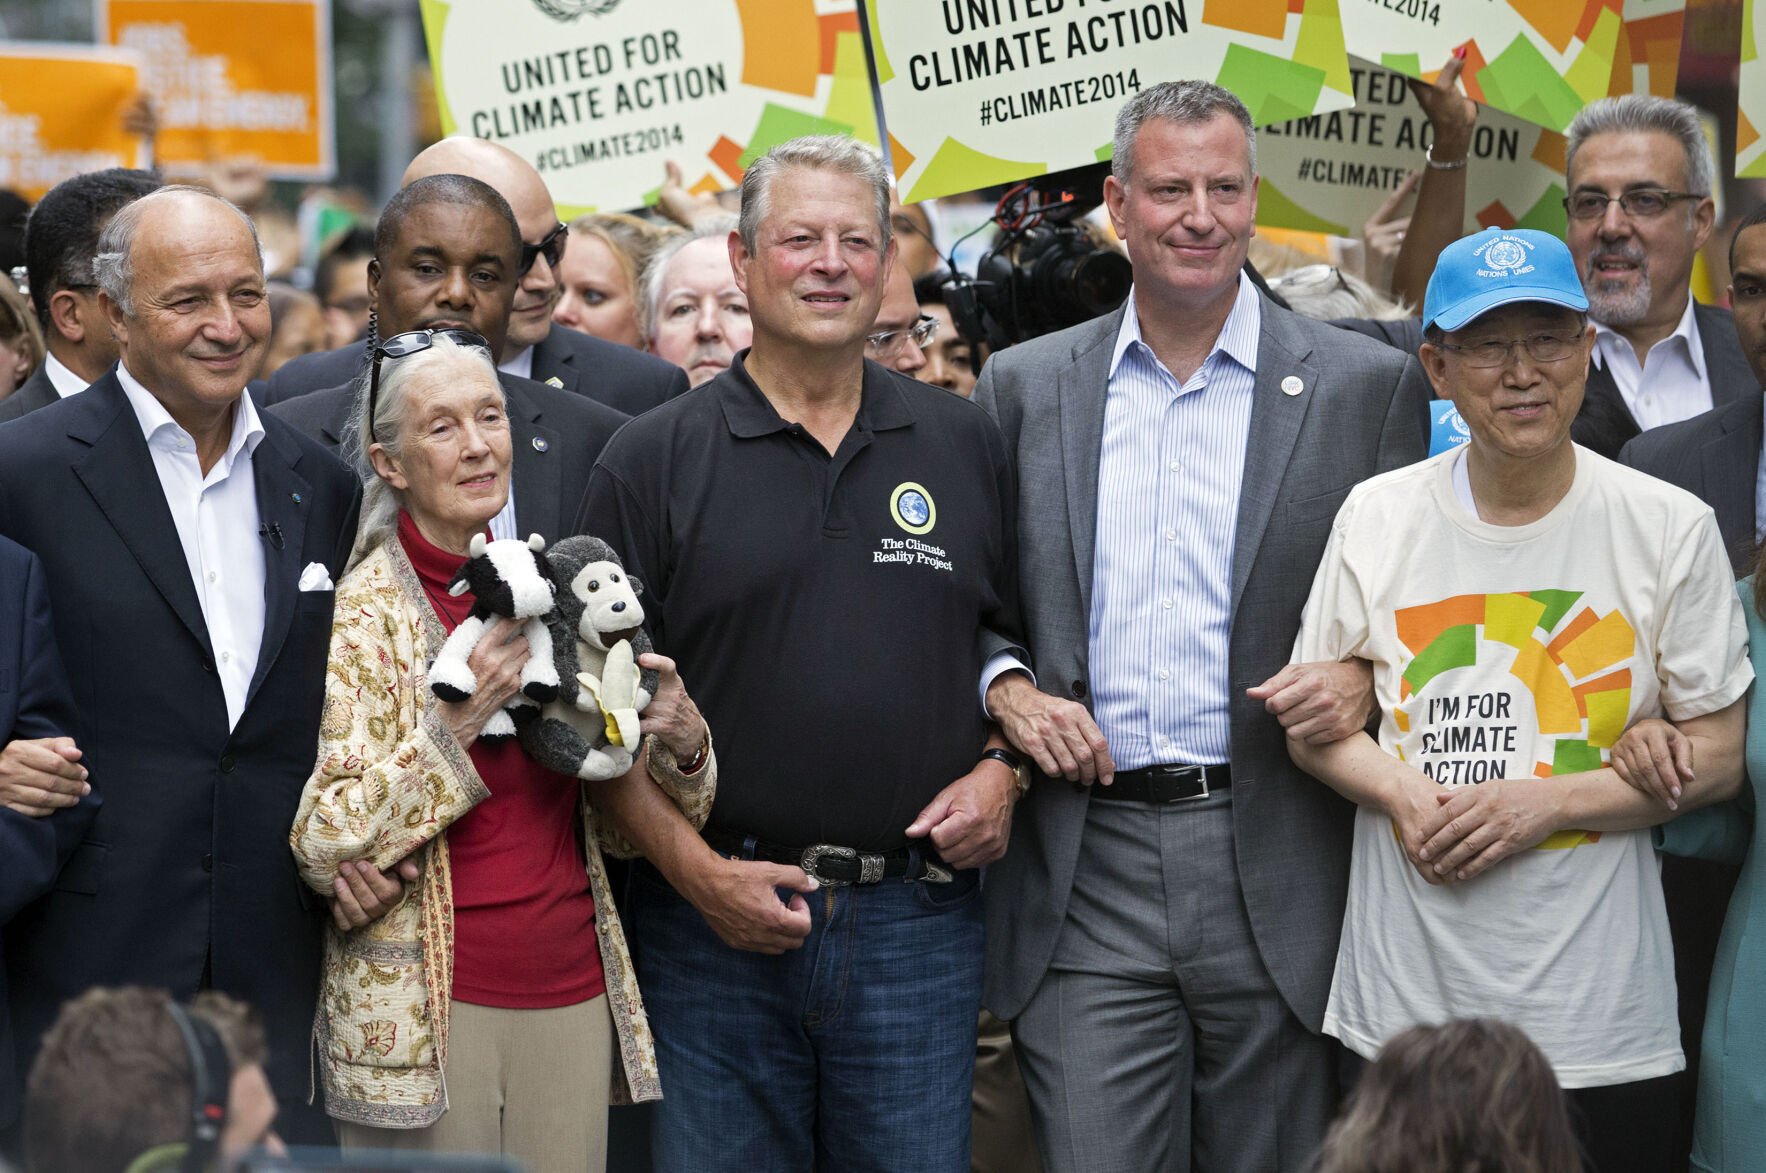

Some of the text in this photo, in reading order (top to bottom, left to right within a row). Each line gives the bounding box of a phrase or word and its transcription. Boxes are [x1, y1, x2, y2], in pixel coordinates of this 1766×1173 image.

[501, 29, 683, 94] UNITED FOR
[908, 0, 1188, 92] CLIMATE ACTION
[471, 61, 728, 141] CLIMATE ACTION
[980, 68, 1142, 127] #CLIMATE2014
[1350, 68, 1408, 105] TED
[535, 124, 685, 173] #CLIMATE2014
[1254, 112, 1520, 161] LIMATE ACON
[1473, 235, 1535, 257] UNITED NATIONS
[1476, 264, 1535, 278] NATIONS UNIES
[872, 550, 953, 571] Reality Project
[881, 538, 946, 557] The Climate
[1428, 692, 1512, 725] I'M FOR
